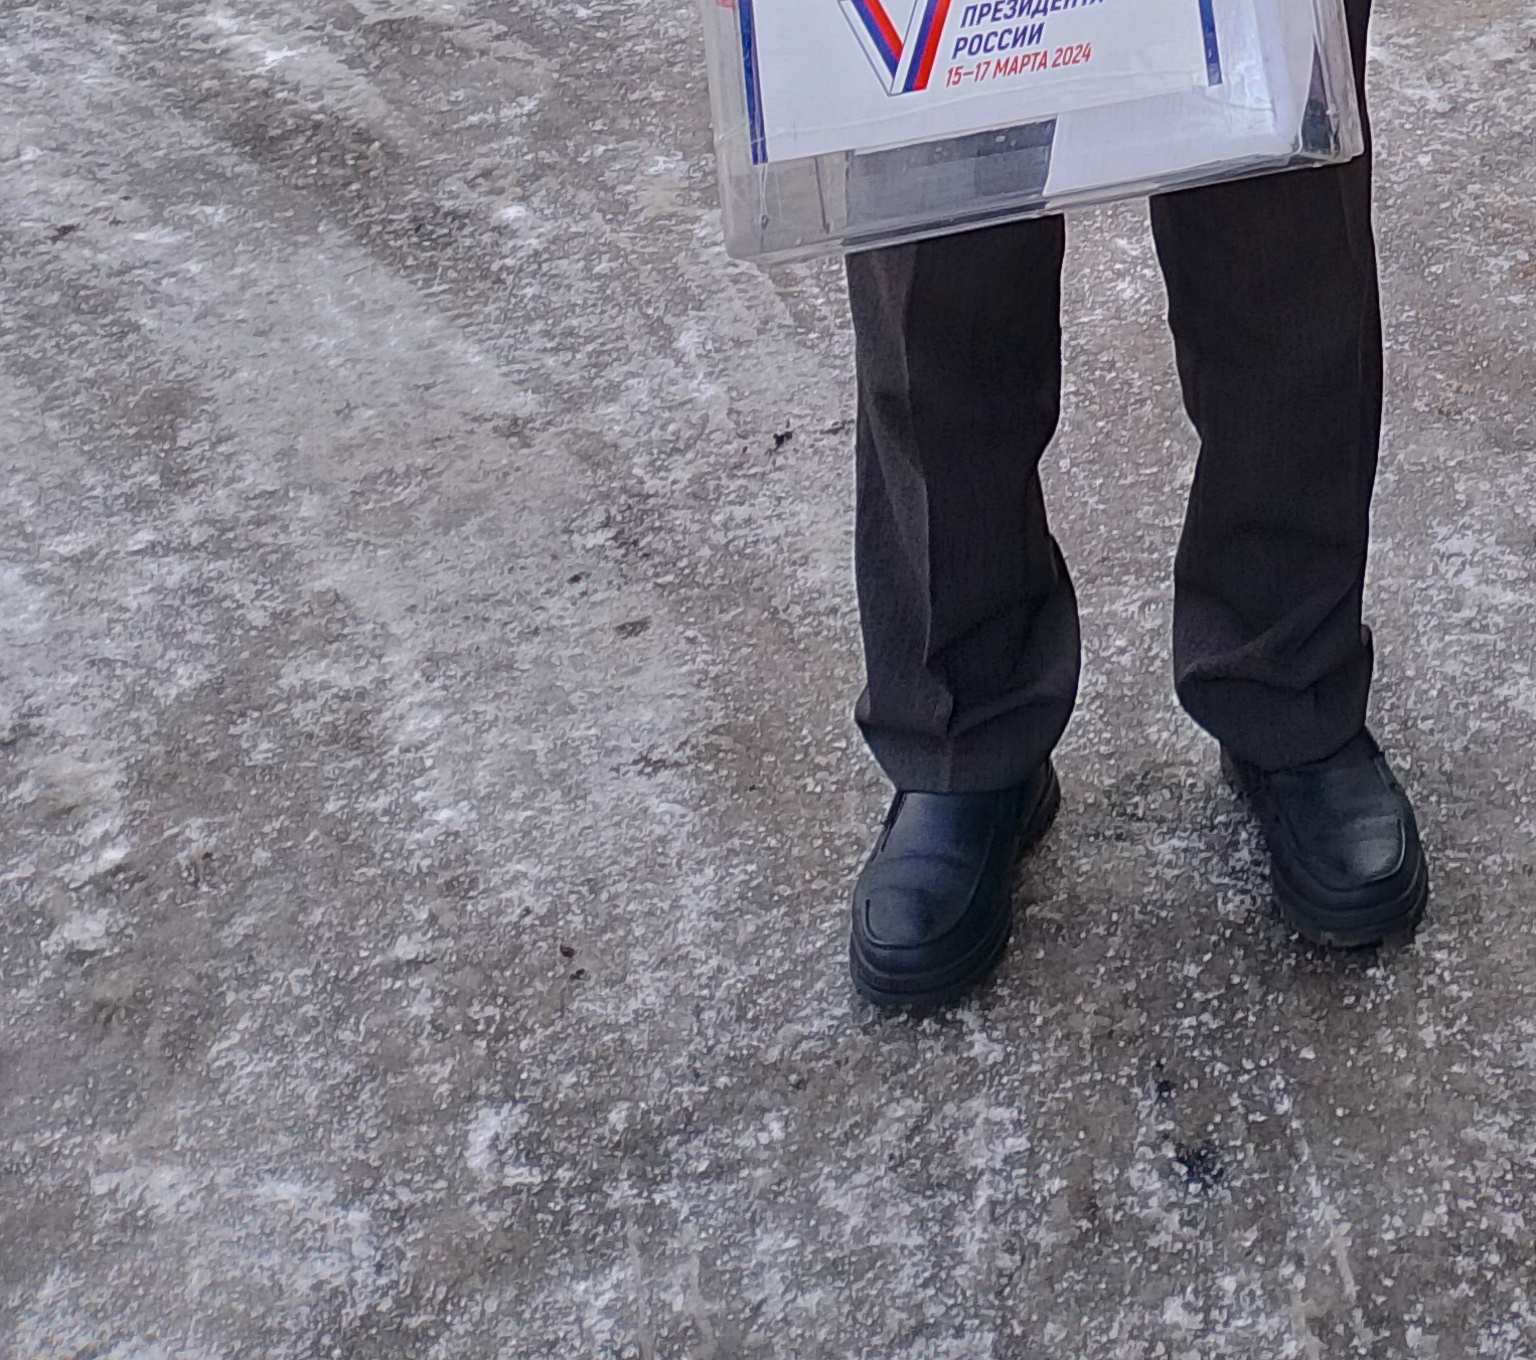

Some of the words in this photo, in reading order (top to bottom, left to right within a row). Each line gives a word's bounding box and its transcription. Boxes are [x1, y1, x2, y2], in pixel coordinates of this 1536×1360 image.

[951, 21, 1046, 60] РОССИИ
[992, 50, 1048, 79] МАРТА
[1051, 42, 1093, 69] 2024
